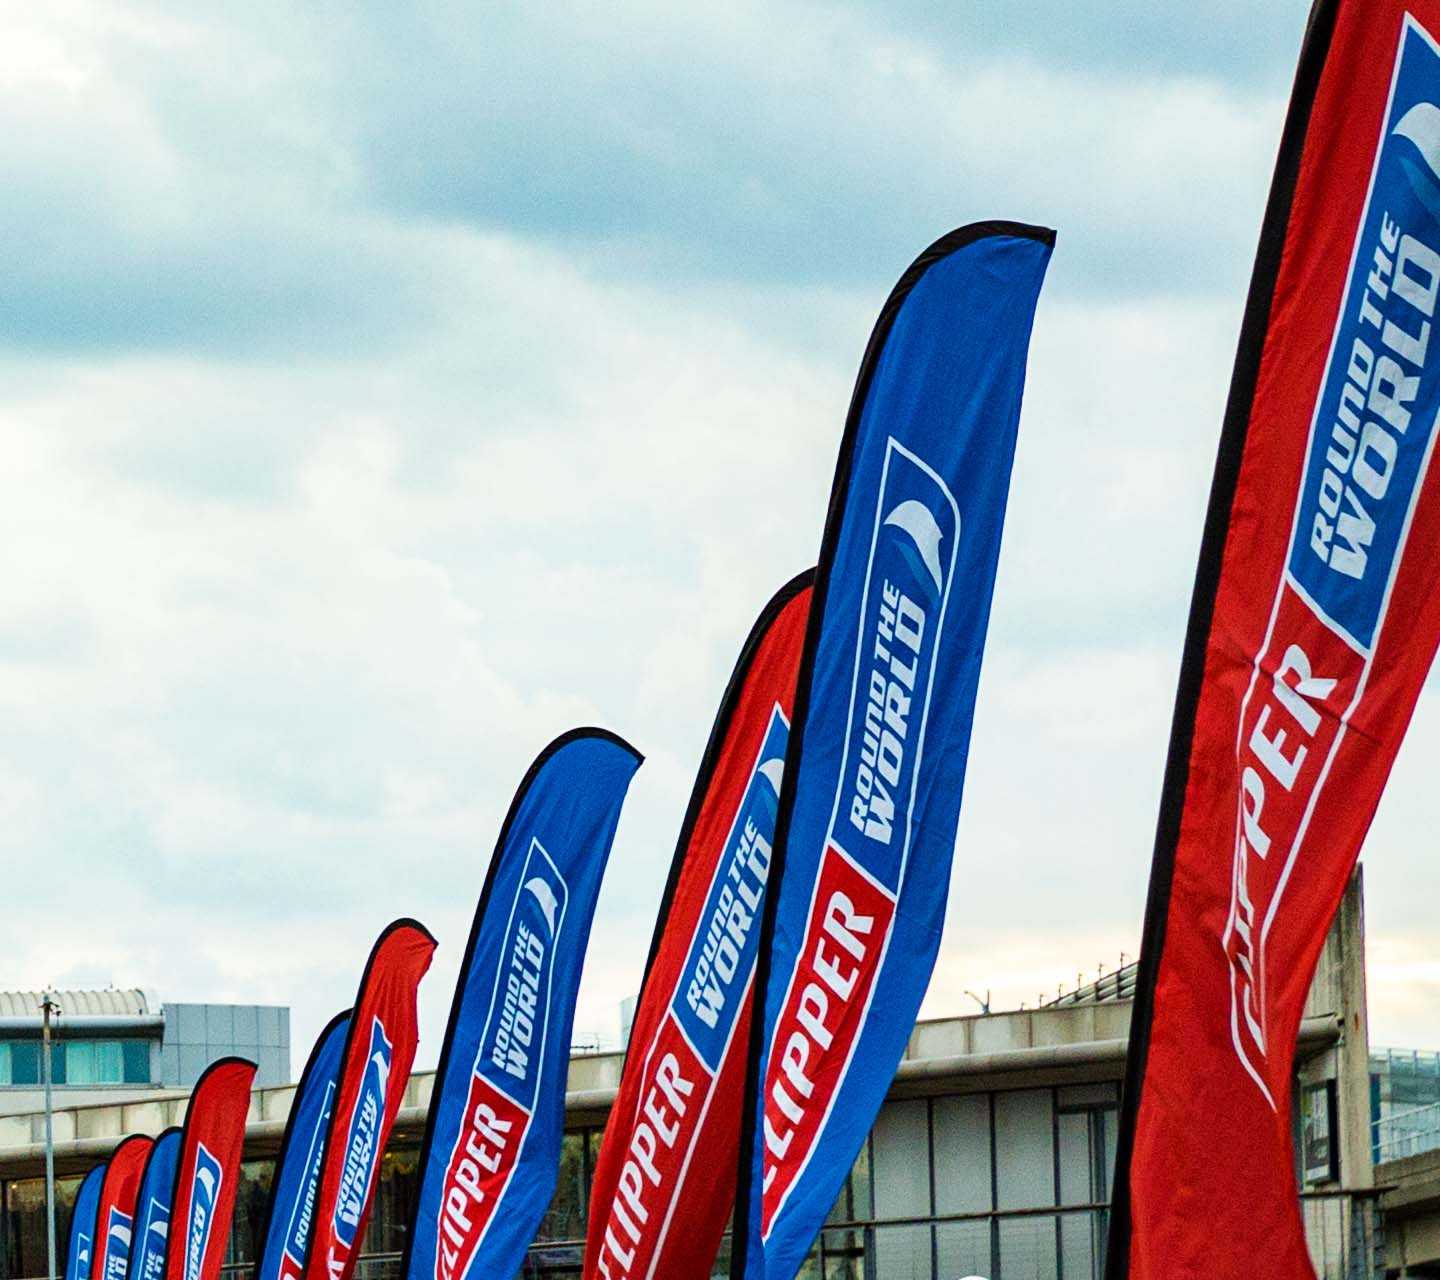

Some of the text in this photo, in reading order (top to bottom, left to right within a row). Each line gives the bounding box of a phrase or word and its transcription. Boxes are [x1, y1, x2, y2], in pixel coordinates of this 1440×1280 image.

[1308, 210, 1401, 562] ROUND THE
[1327, 236, 1440, 581] WORLD
[851, 582, 901, 834] ROUND THE
[863, 600, 928, 848] WORLD
[491, 918, 530, 1069] ROUND THE
[506, 932, 545, 1083] WORLD
[684, 816, 758, 1010] ROUND THE
[695, 832, 773, 1031] WORLD
[762, 888, 876, 1195] LIPPER
[295, 1172, 321, 1252] ROUND
[338, 1087, 376, 1218] ROUND THE
